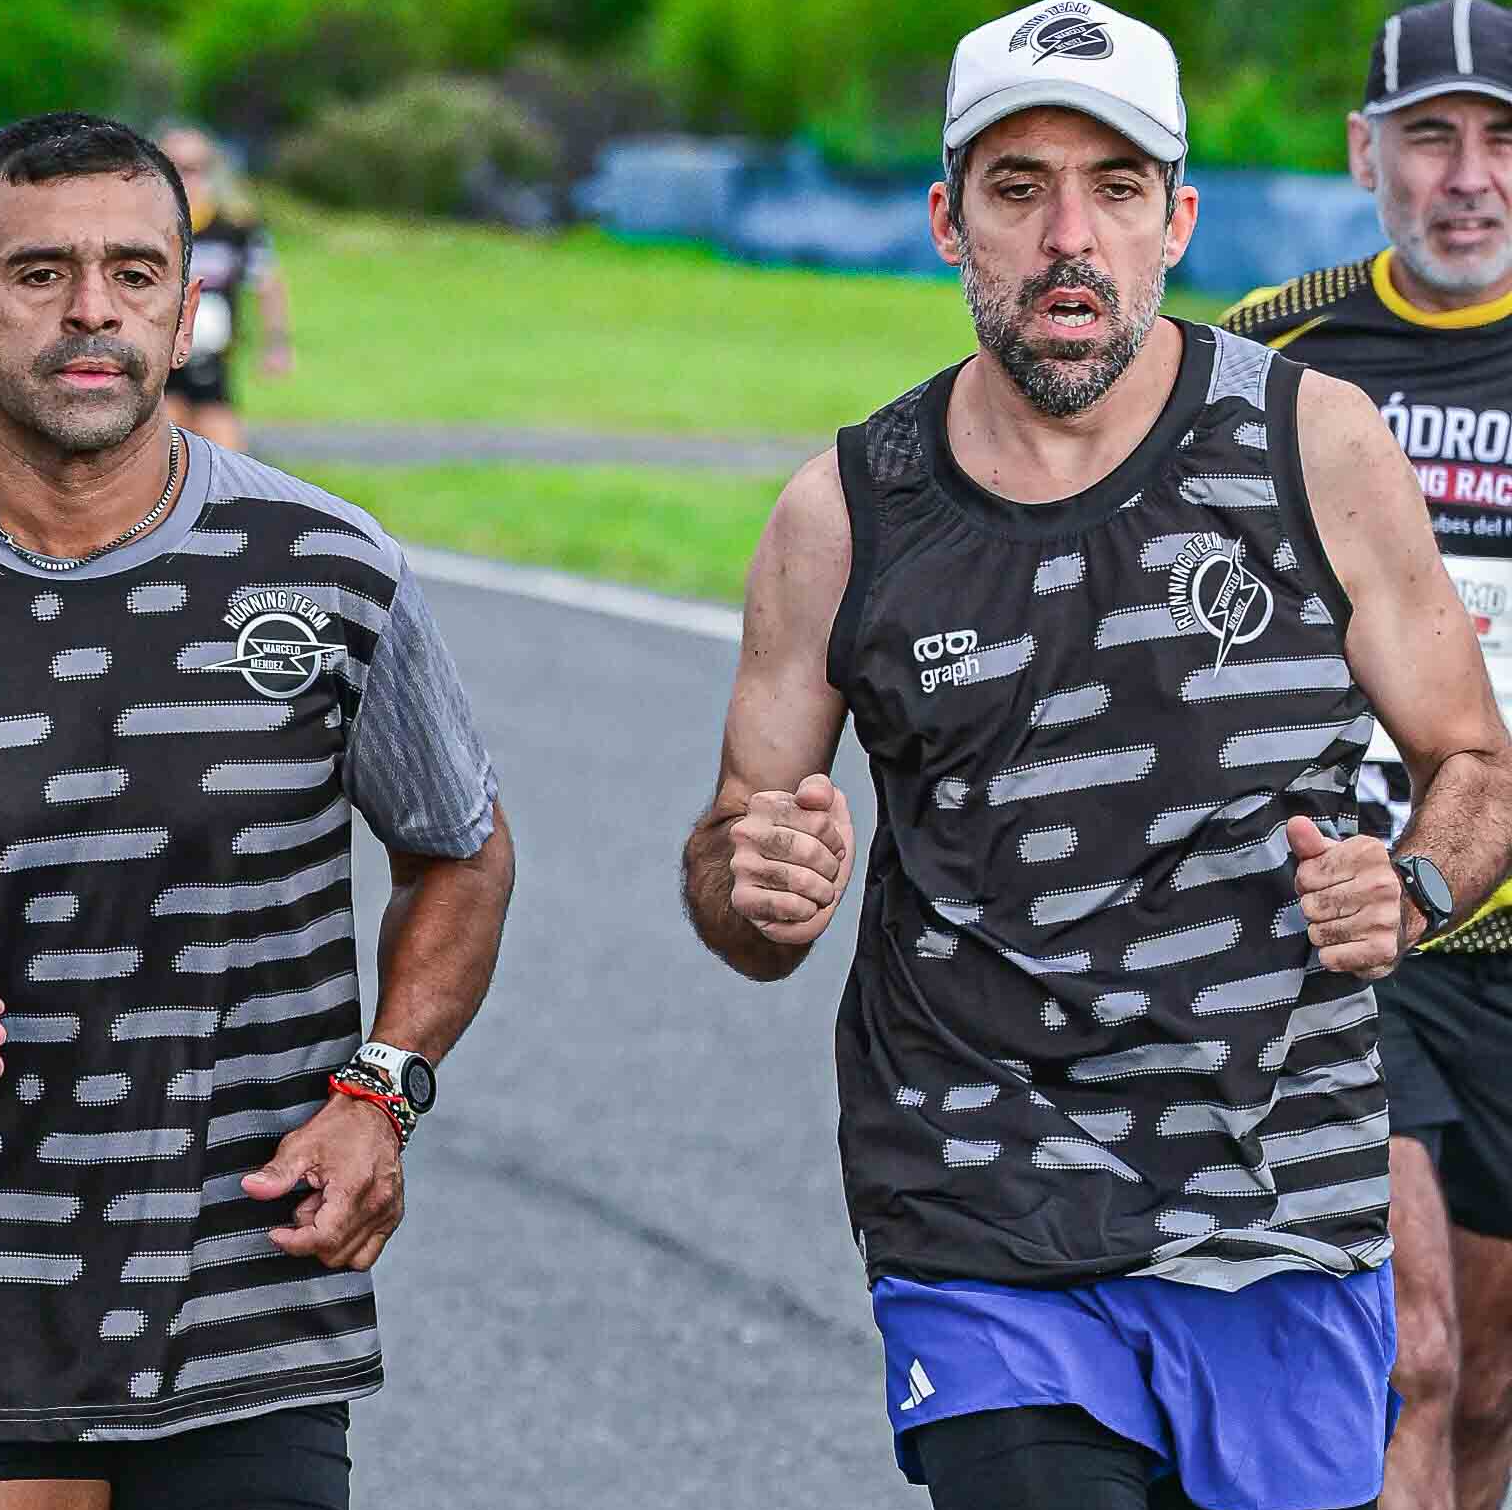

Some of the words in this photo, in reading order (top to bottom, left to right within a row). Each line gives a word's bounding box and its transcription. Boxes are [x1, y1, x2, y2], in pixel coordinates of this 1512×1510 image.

[1380, 391, 1512, 466] ÓDRO
[1168, 552, 1196, 631] RUNNING
[1184, 531, 1223, 558] TEAM
[222, 591, 287, 631] RUNNING
[292, 593, 331, 632] TEAM
[250, 657, 284, 670] MENDEZ
[262, 644, 301, 656] MARCELO
[920, 653, 980, 694] graph
